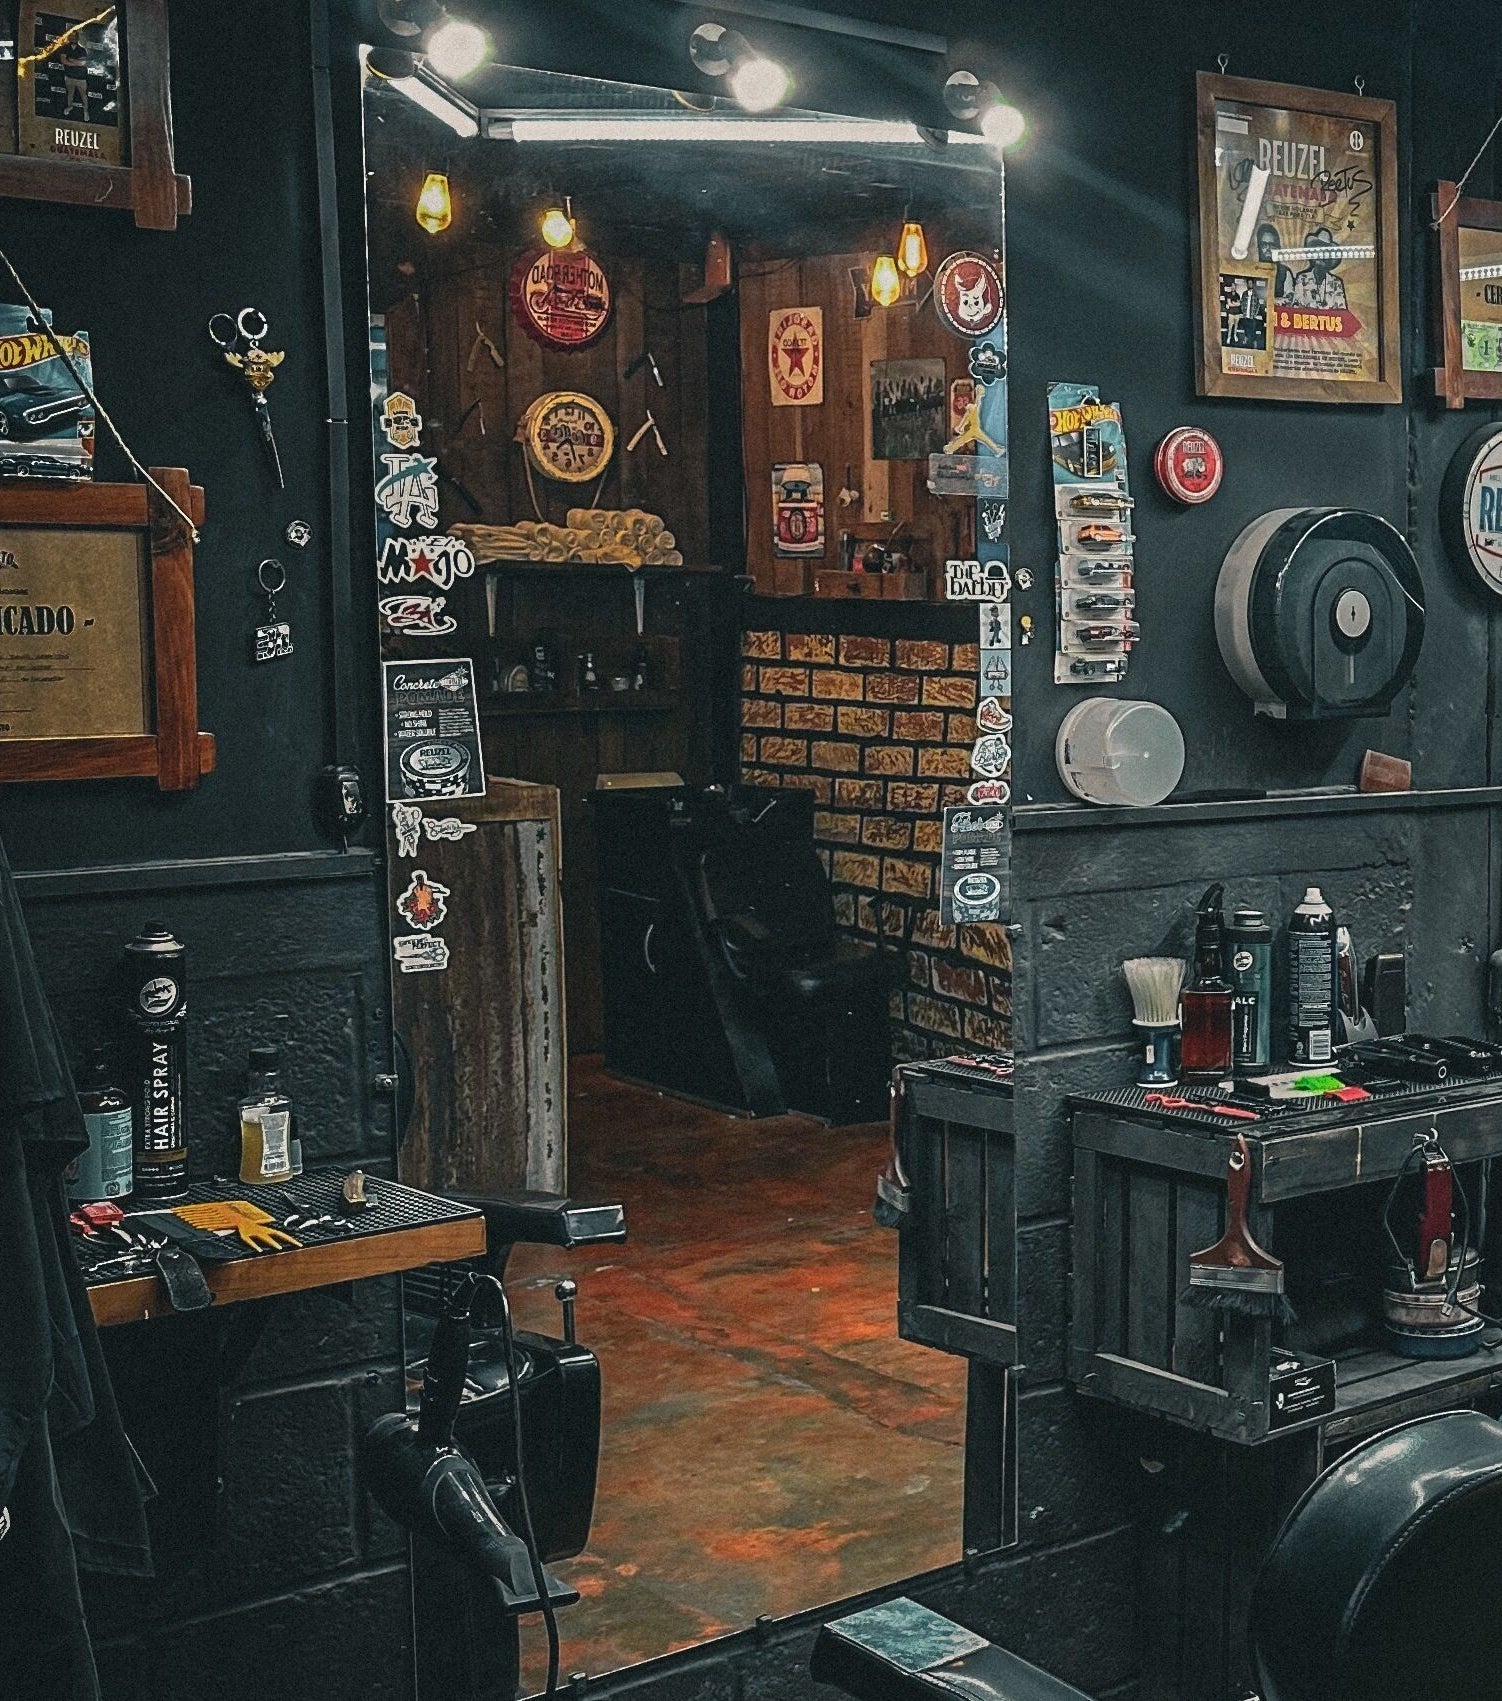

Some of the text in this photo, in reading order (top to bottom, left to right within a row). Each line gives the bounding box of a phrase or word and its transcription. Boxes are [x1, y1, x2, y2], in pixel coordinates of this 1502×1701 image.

[55, 128, 100, 150] REUZEL
[1259, 137, 1330, 182] REUZEL
[1293, 313, 1343, 332] BERTUS
[1235, 997, 1256, 1005] ALC
[152, 1042, 169, 1150] HAIR SPRAY
